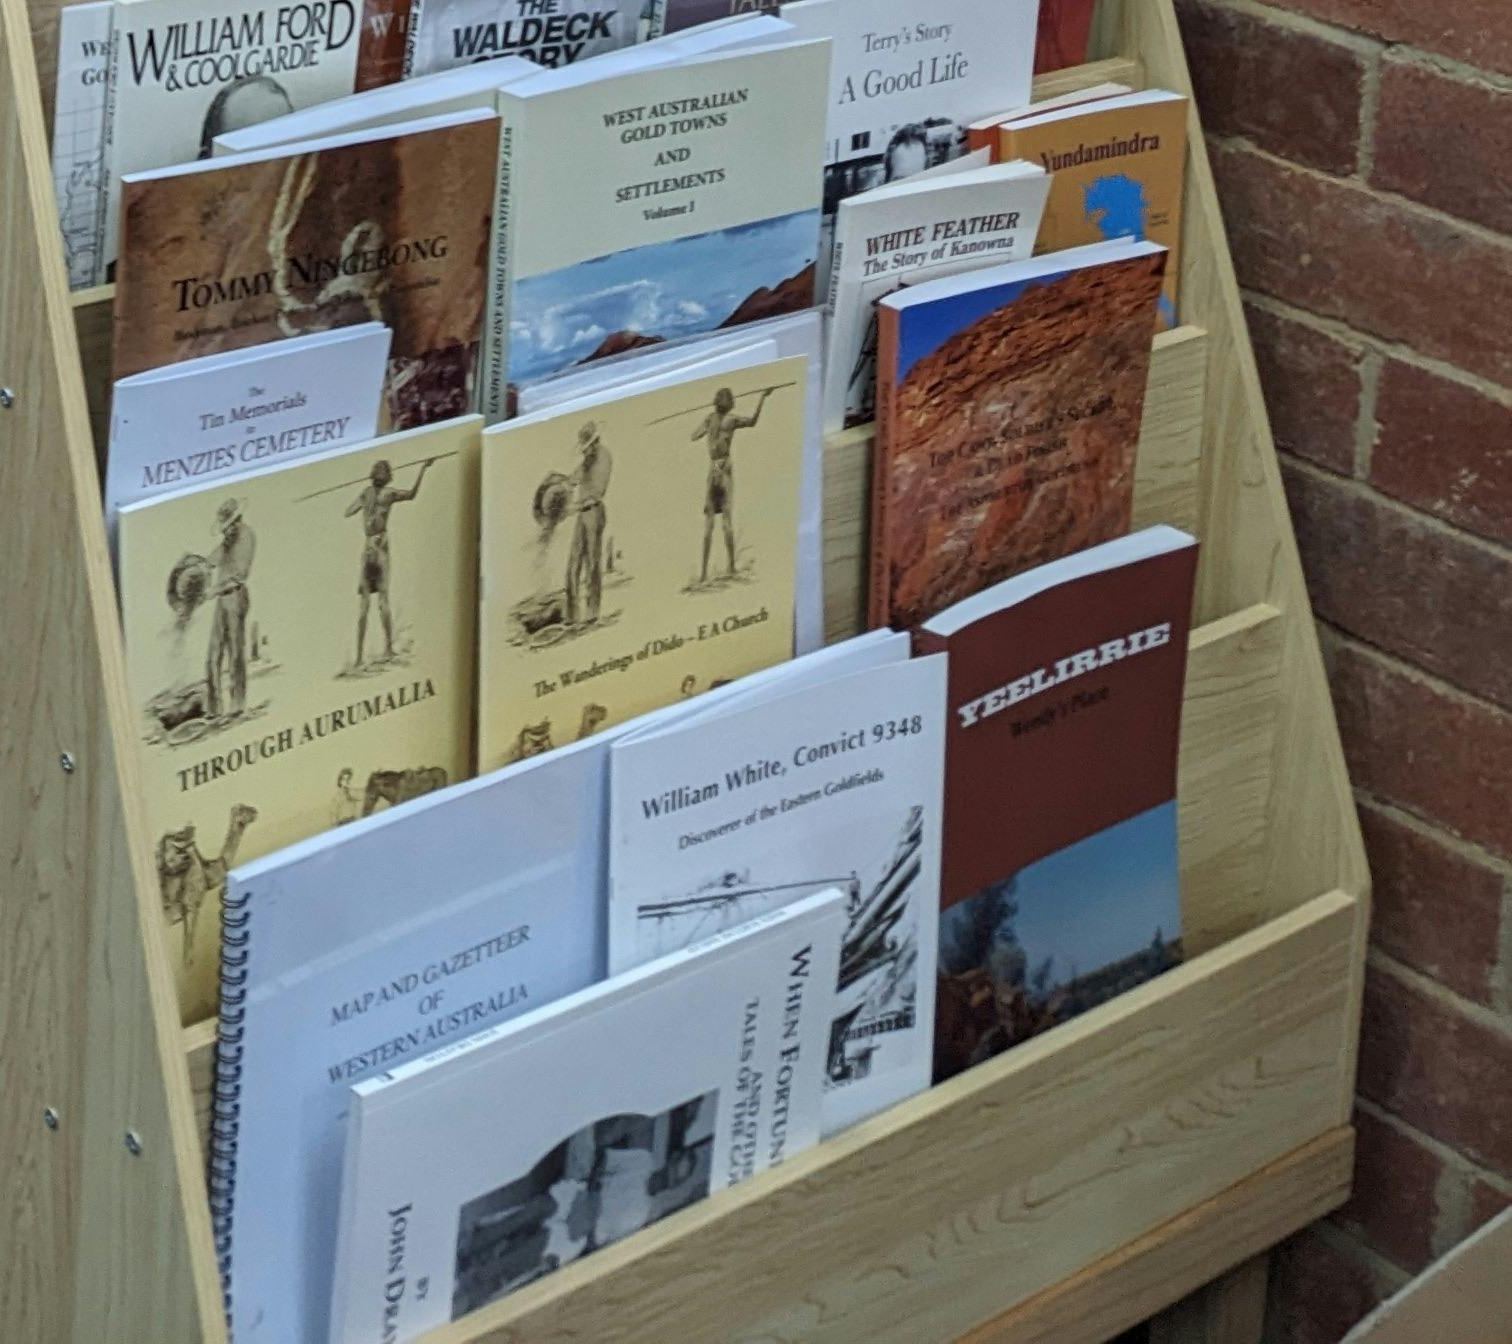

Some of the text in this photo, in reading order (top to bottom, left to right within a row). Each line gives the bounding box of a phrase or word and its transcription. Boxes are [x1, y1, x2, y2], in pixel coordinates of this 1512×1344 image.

[127, 11, 265, 86] WILLIAM
[454, 10, 617, 58] WALDECK
[862, 21, 953, 55] Terry's Story
[165, 40, 319, 92] & COOLGARDIE
[839, 53, 969, 104] A Good Life
[603, 88, 749, 127] WEST AUSTRALIAN
[620, 112, 727, 144] GOLD TOWNS
[654, 147, 691, 166] AND
[1040, 132, 1160, 174] Yundamindra
[615, 168, 726, 203] SETTLEMENTS
[863, 235, 1014, 276] The Story of Kanowna
[866, 212, 1020, 258] WHITE FEATHER
[141, 416, 351, 489] MENZIES CEMETERY
[957, 621, 1172, 729] YEELIRRIE
[176, 676, 437, 794] THROUGH AURUMALIA
[641, 714, 923, 821] William White, Convict 9348
[330, 924, 532, 1027] MAP AND GAZETTEER
[417, 989, 446, 1016] OF
[327, 983, 530, 1085] WESTERN AUSTRALIA
